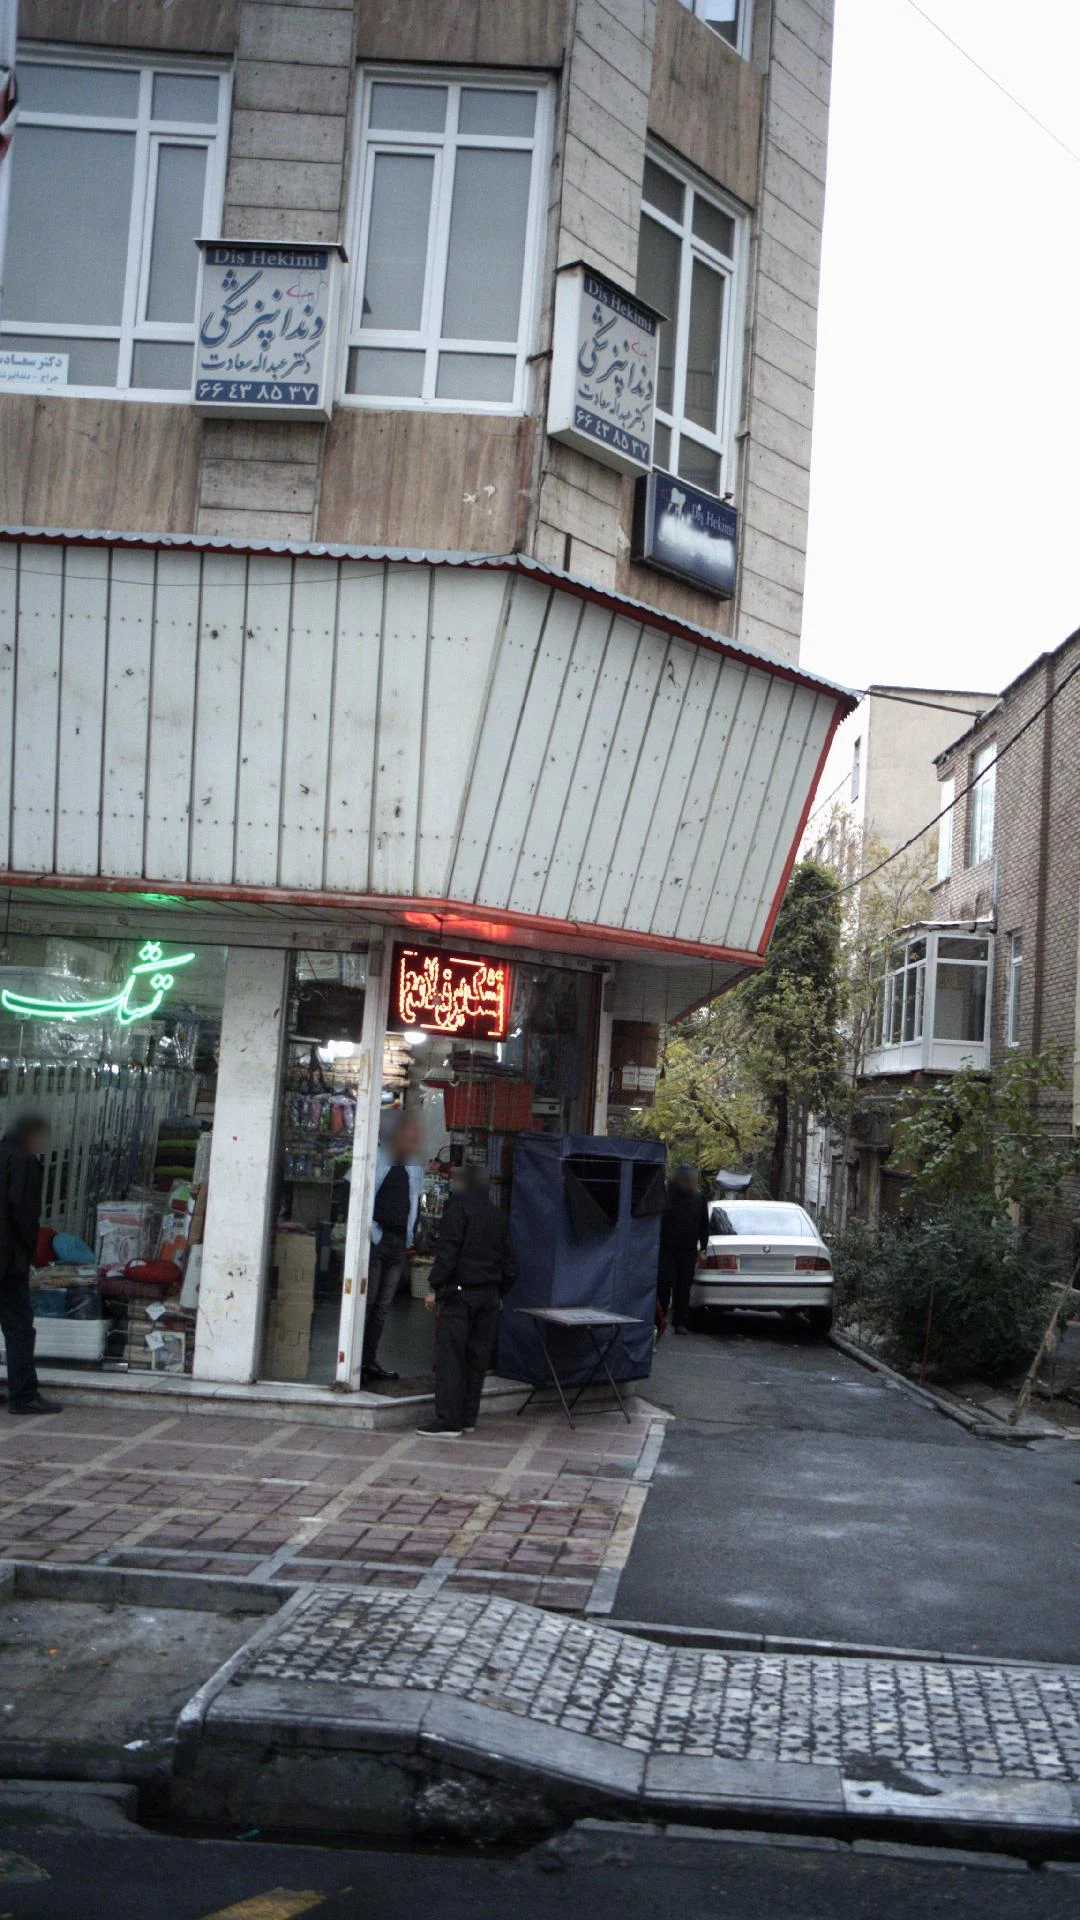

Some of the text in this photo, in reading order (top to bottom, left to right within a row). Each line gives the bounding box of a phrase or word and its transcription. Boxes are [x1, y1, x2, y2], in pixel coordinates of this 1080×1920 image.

[250, 249, 321, 268] Hekimi
[199, 269, 326, 351] دندانپزشکی
[610, 294, 653, 331] Hekimi
[36, 355, 63, 370] دکتر
[201, 352, 253, 372] سعادت
[282, 340, 321, 380] دکتر
[577, 304, 654, 400] دندانپزشکی
[577, 385, 610, 412] سعادت
[626, 403, 651, 433] دکتر
[706, 511, 736, 537] Hekimi
[1, 940, 196, 1026] تشک
